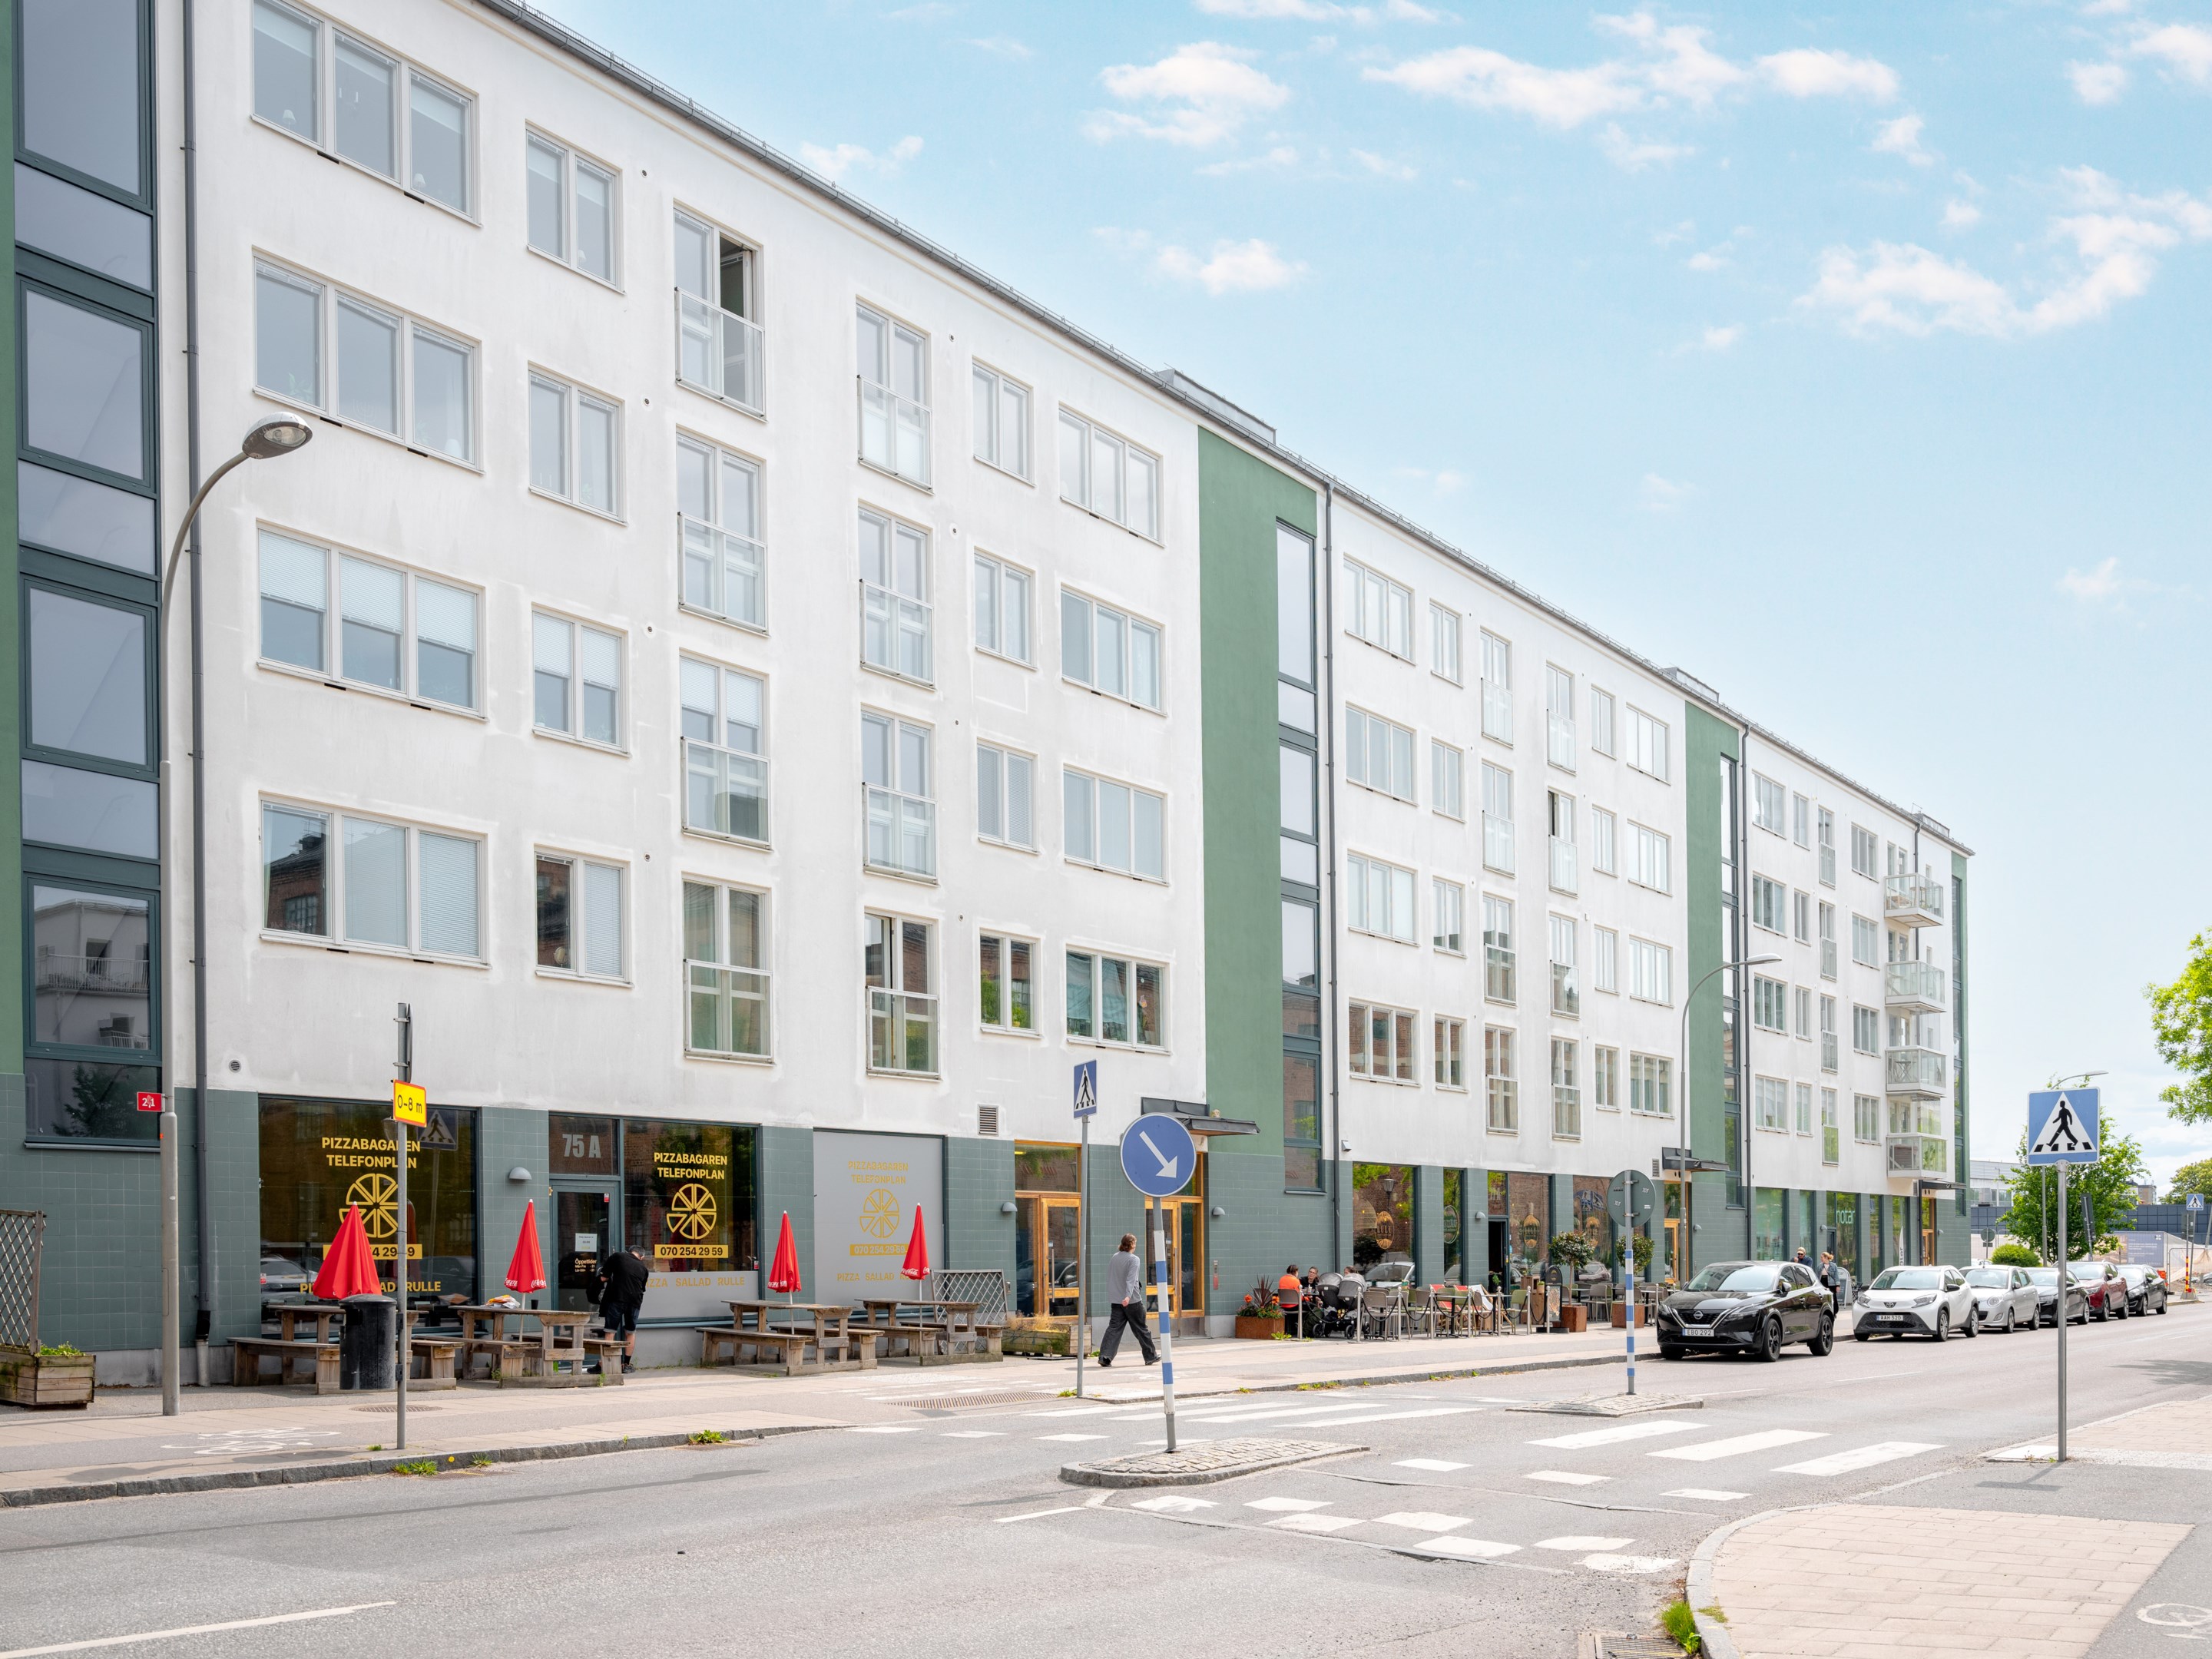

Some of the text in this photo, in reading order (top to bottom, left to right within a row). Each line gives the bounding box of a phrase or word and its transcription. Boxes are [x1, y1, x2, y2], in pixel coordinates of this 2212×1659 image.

[397, 1094, 422, 1114] 0-8 m
[322, 1137, 421, 1152] PIZZABAGAEN
[562, 1134, 601, 1158] 75 A
[326, 1154, 417, 1168] TELEFONPLN
[654, 1152, 727, 1165] PIZZABAGAREN
[848, 1161, 909, 1171] PIZZABAGAREN
[657, 1167, 725, 1180] TELEFONPLAN
[851, 1174, 906, 1184] TELEFONPLAN
[1836, 1207, 1856, 1224] notar
[661, 1247, 723, 1256] 070 254 29 59
[647, 1277, 745, 1288] IZZA SALLAD RULLE
[837, 1273, 860, 1281] PIZZA
[406, 1281, 442, 1292] RULLE
